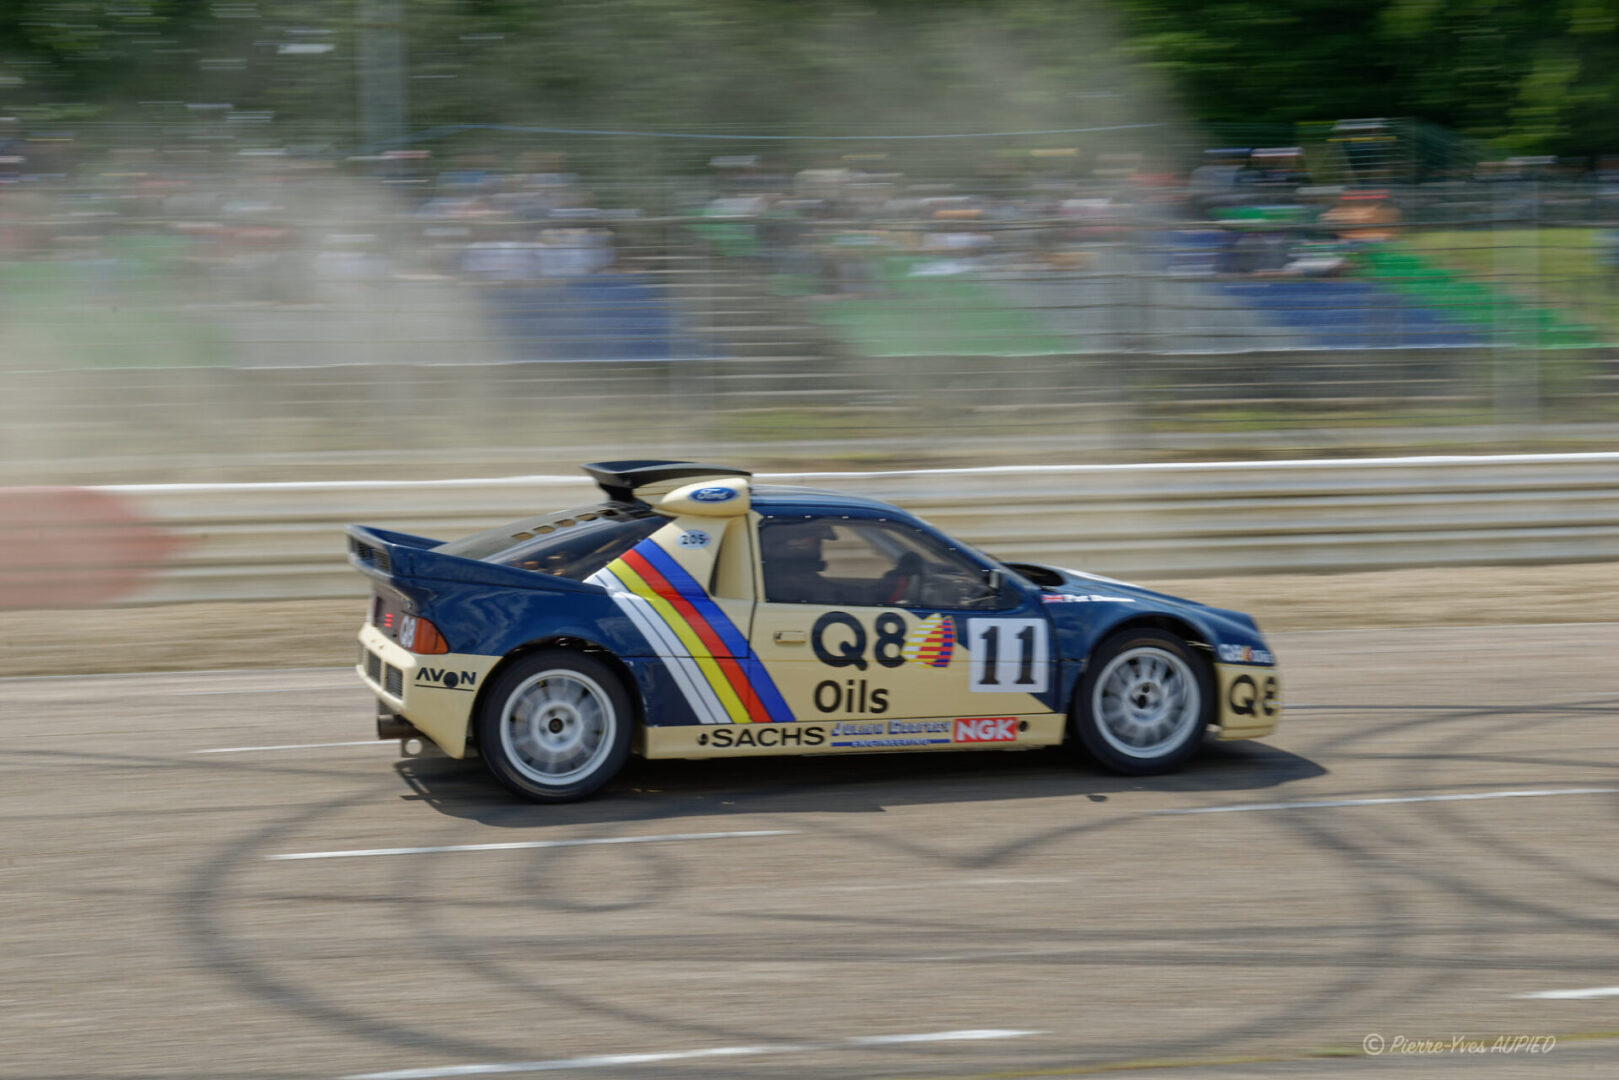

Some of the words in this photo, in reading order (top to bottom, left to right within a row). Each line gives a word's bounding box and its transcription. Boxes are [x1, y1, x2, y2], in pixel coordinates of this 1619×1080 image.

[697, 489, 729, 500] Ford
[811, 611, 907, 671] Q8
[978, 625, 1036, 685] 11
[416, 667, 476, 688] AVON
[814, 679, 889, 713] Oils
[711, 727, 825, 748] SACHS
[956, 719, 1015, 741] NGK
